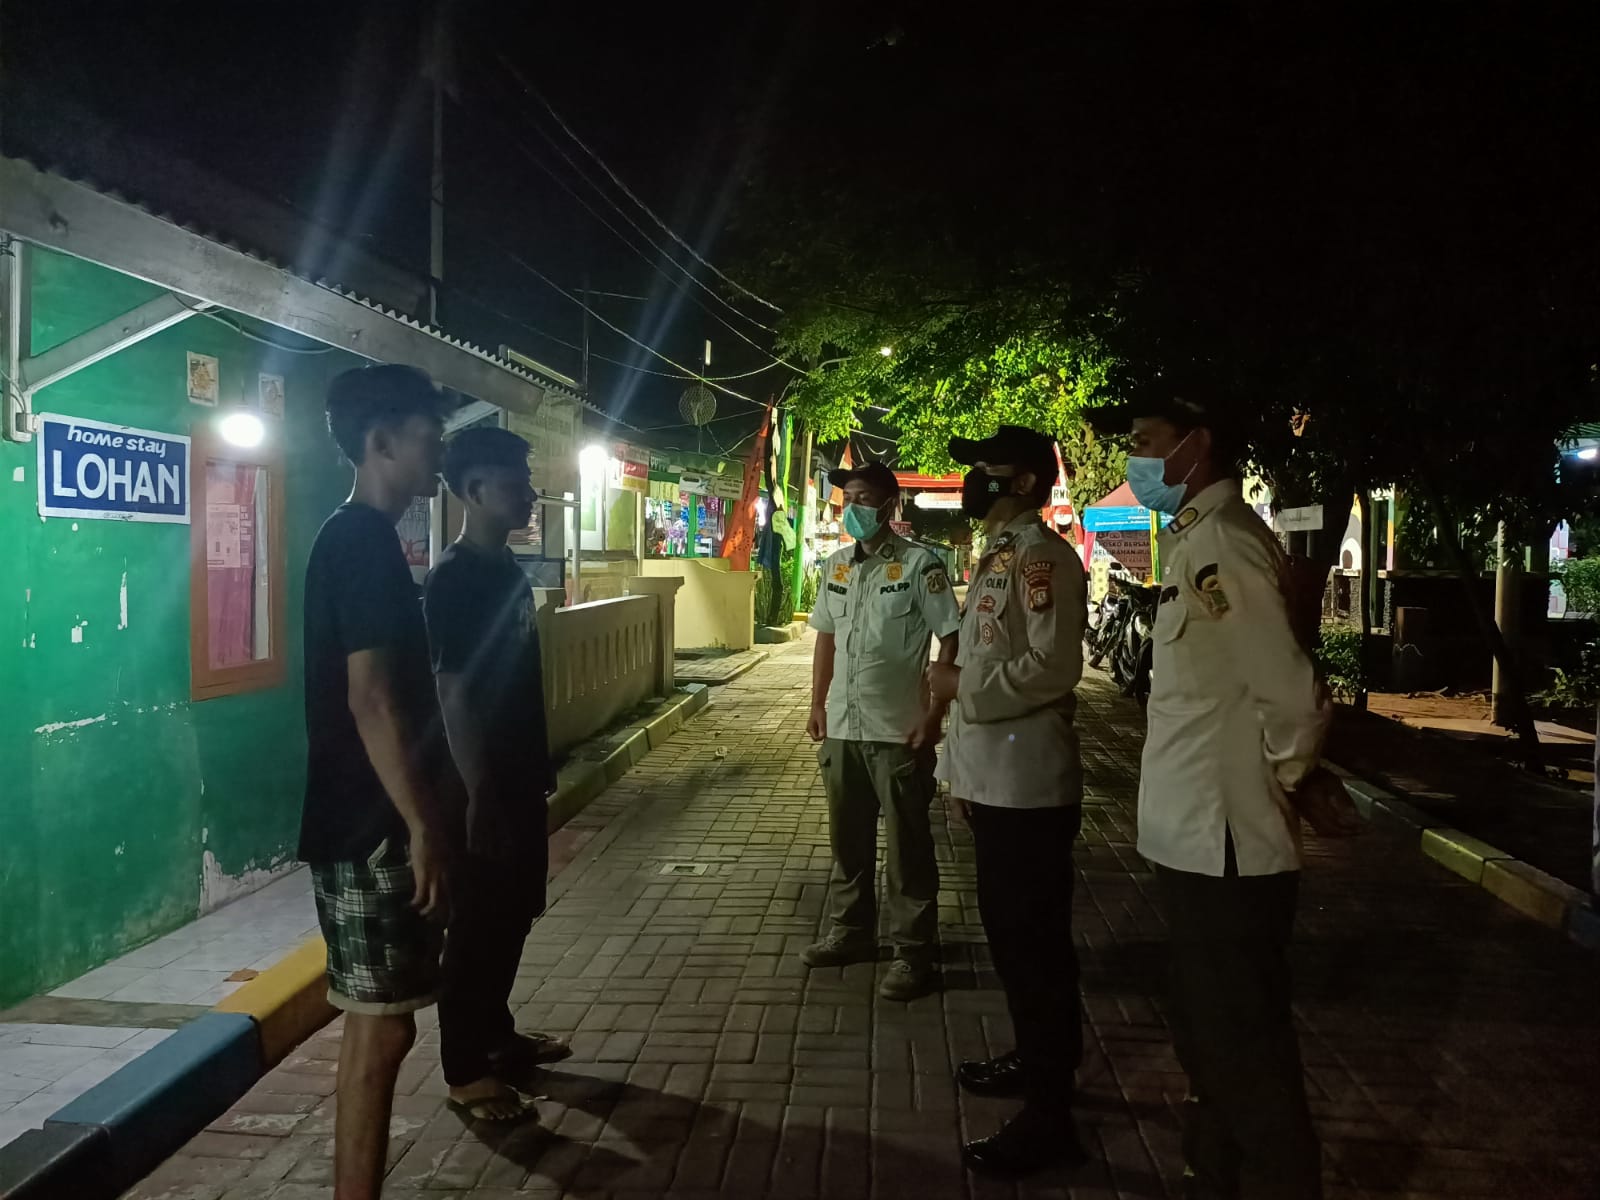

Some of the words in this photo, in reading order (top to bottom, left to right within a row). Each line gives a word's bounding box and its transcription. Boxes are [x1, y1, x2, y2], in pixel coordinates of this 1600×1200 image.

[125, 437, 166, 458] stay
[53, 449, 180, 505] LOHAN
[985, 577, 1008, 590] OLRI
